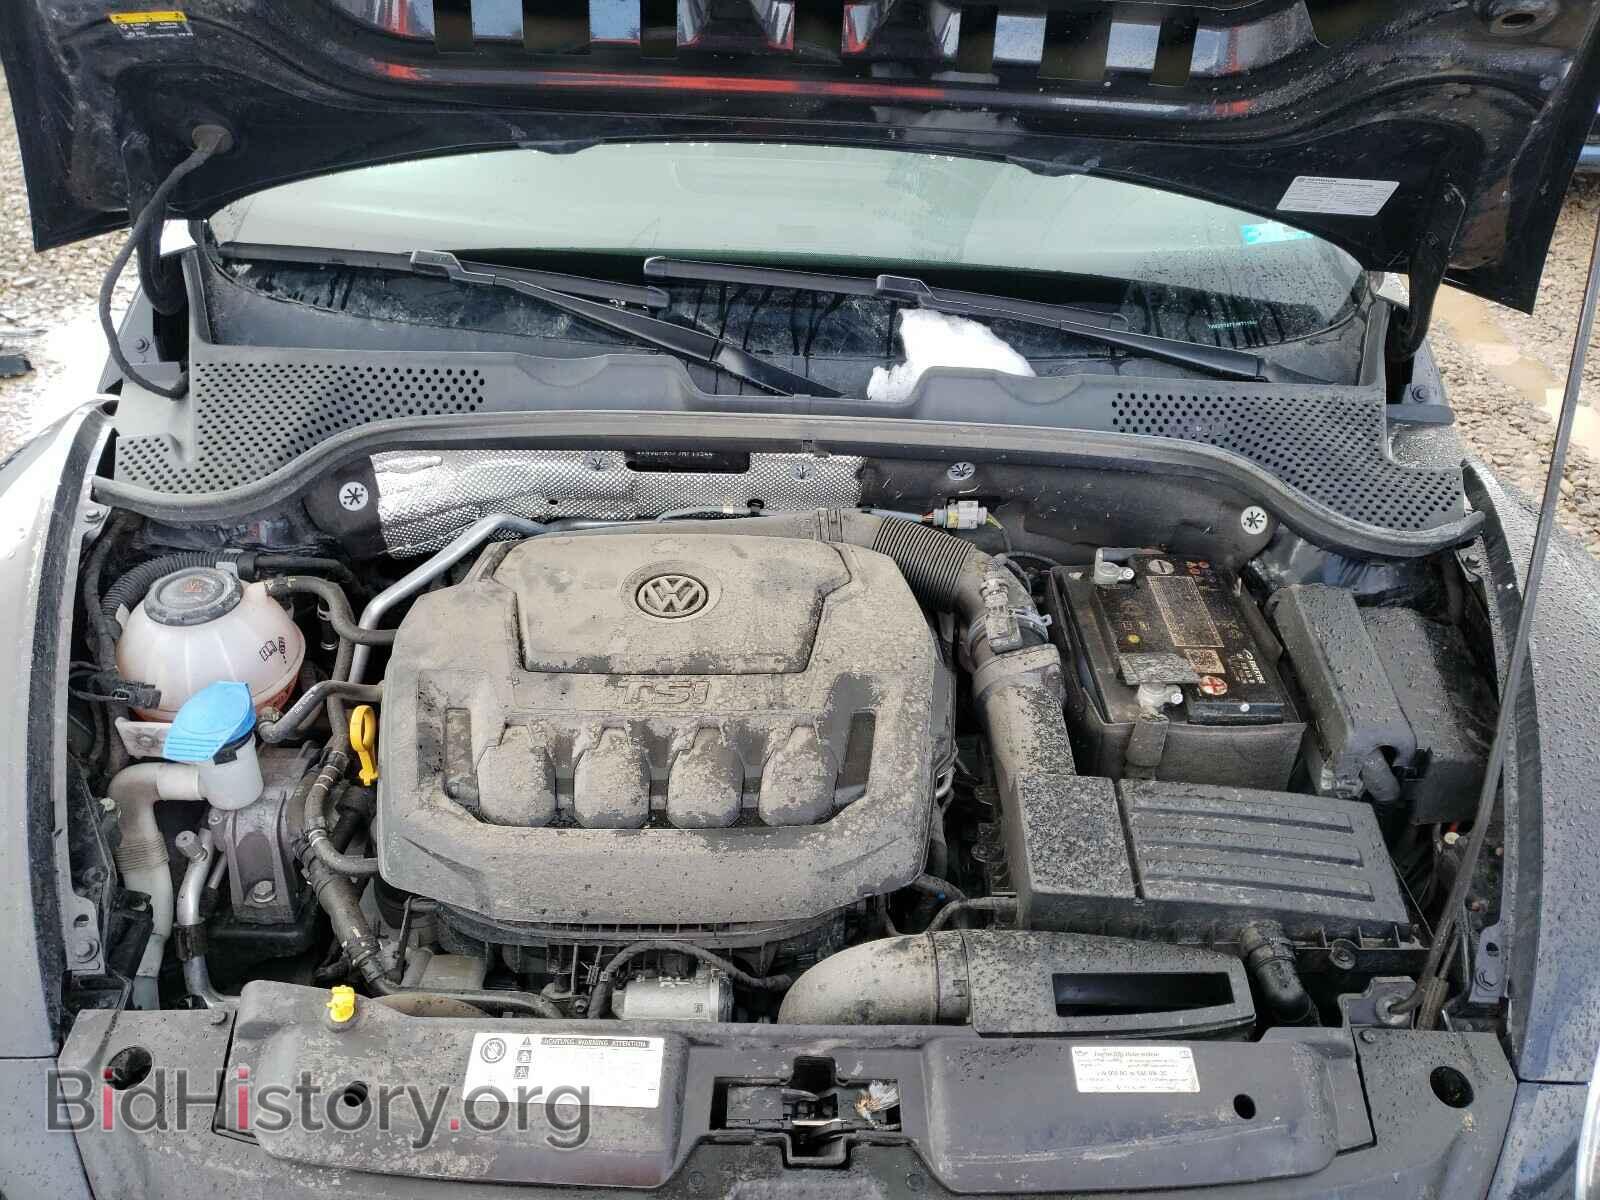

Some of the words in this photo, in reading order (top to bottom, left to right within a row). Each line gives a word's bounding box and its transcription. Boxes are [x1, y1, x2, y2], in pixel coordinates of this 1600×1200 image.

[617, 680, 711, 705] TSI
[577, 1038, 609, 1047] WARNING
[610, 1039, 648, 1048] ATTENTION
